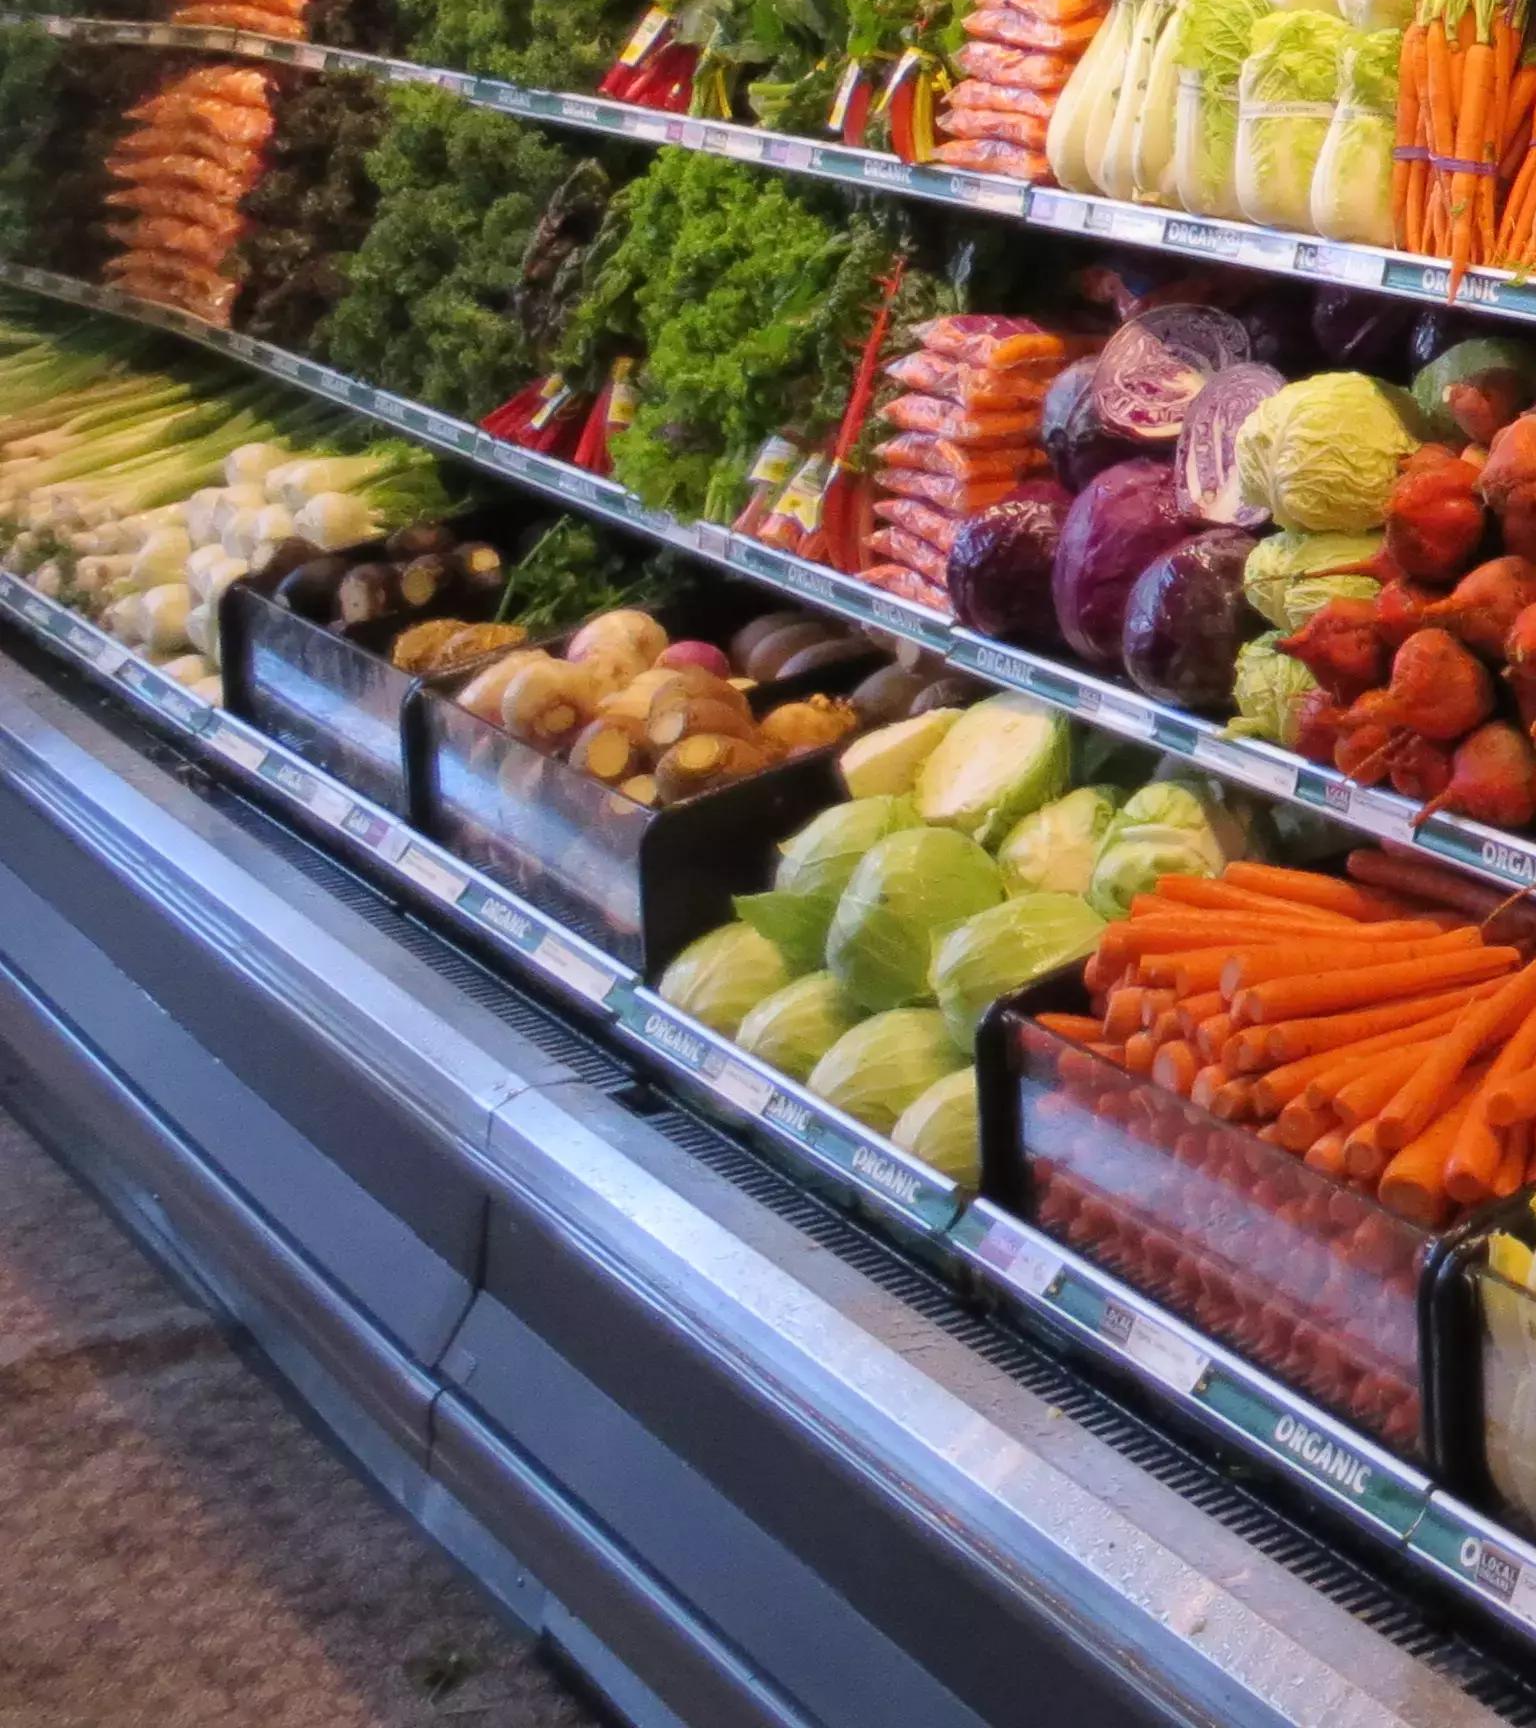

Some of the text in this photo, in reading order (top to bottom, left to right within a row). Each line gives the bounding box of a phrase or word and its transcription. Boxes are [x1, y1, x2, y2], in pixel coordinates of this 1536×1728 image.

[645, 1013, 706, 1063] ORGANIC
[852, 1145, 922, 1204] ORGANIC
[1274, 1413, 1373, 1494] ORGANIC
[1480, 1549, 1518, 1578] LOCAL
